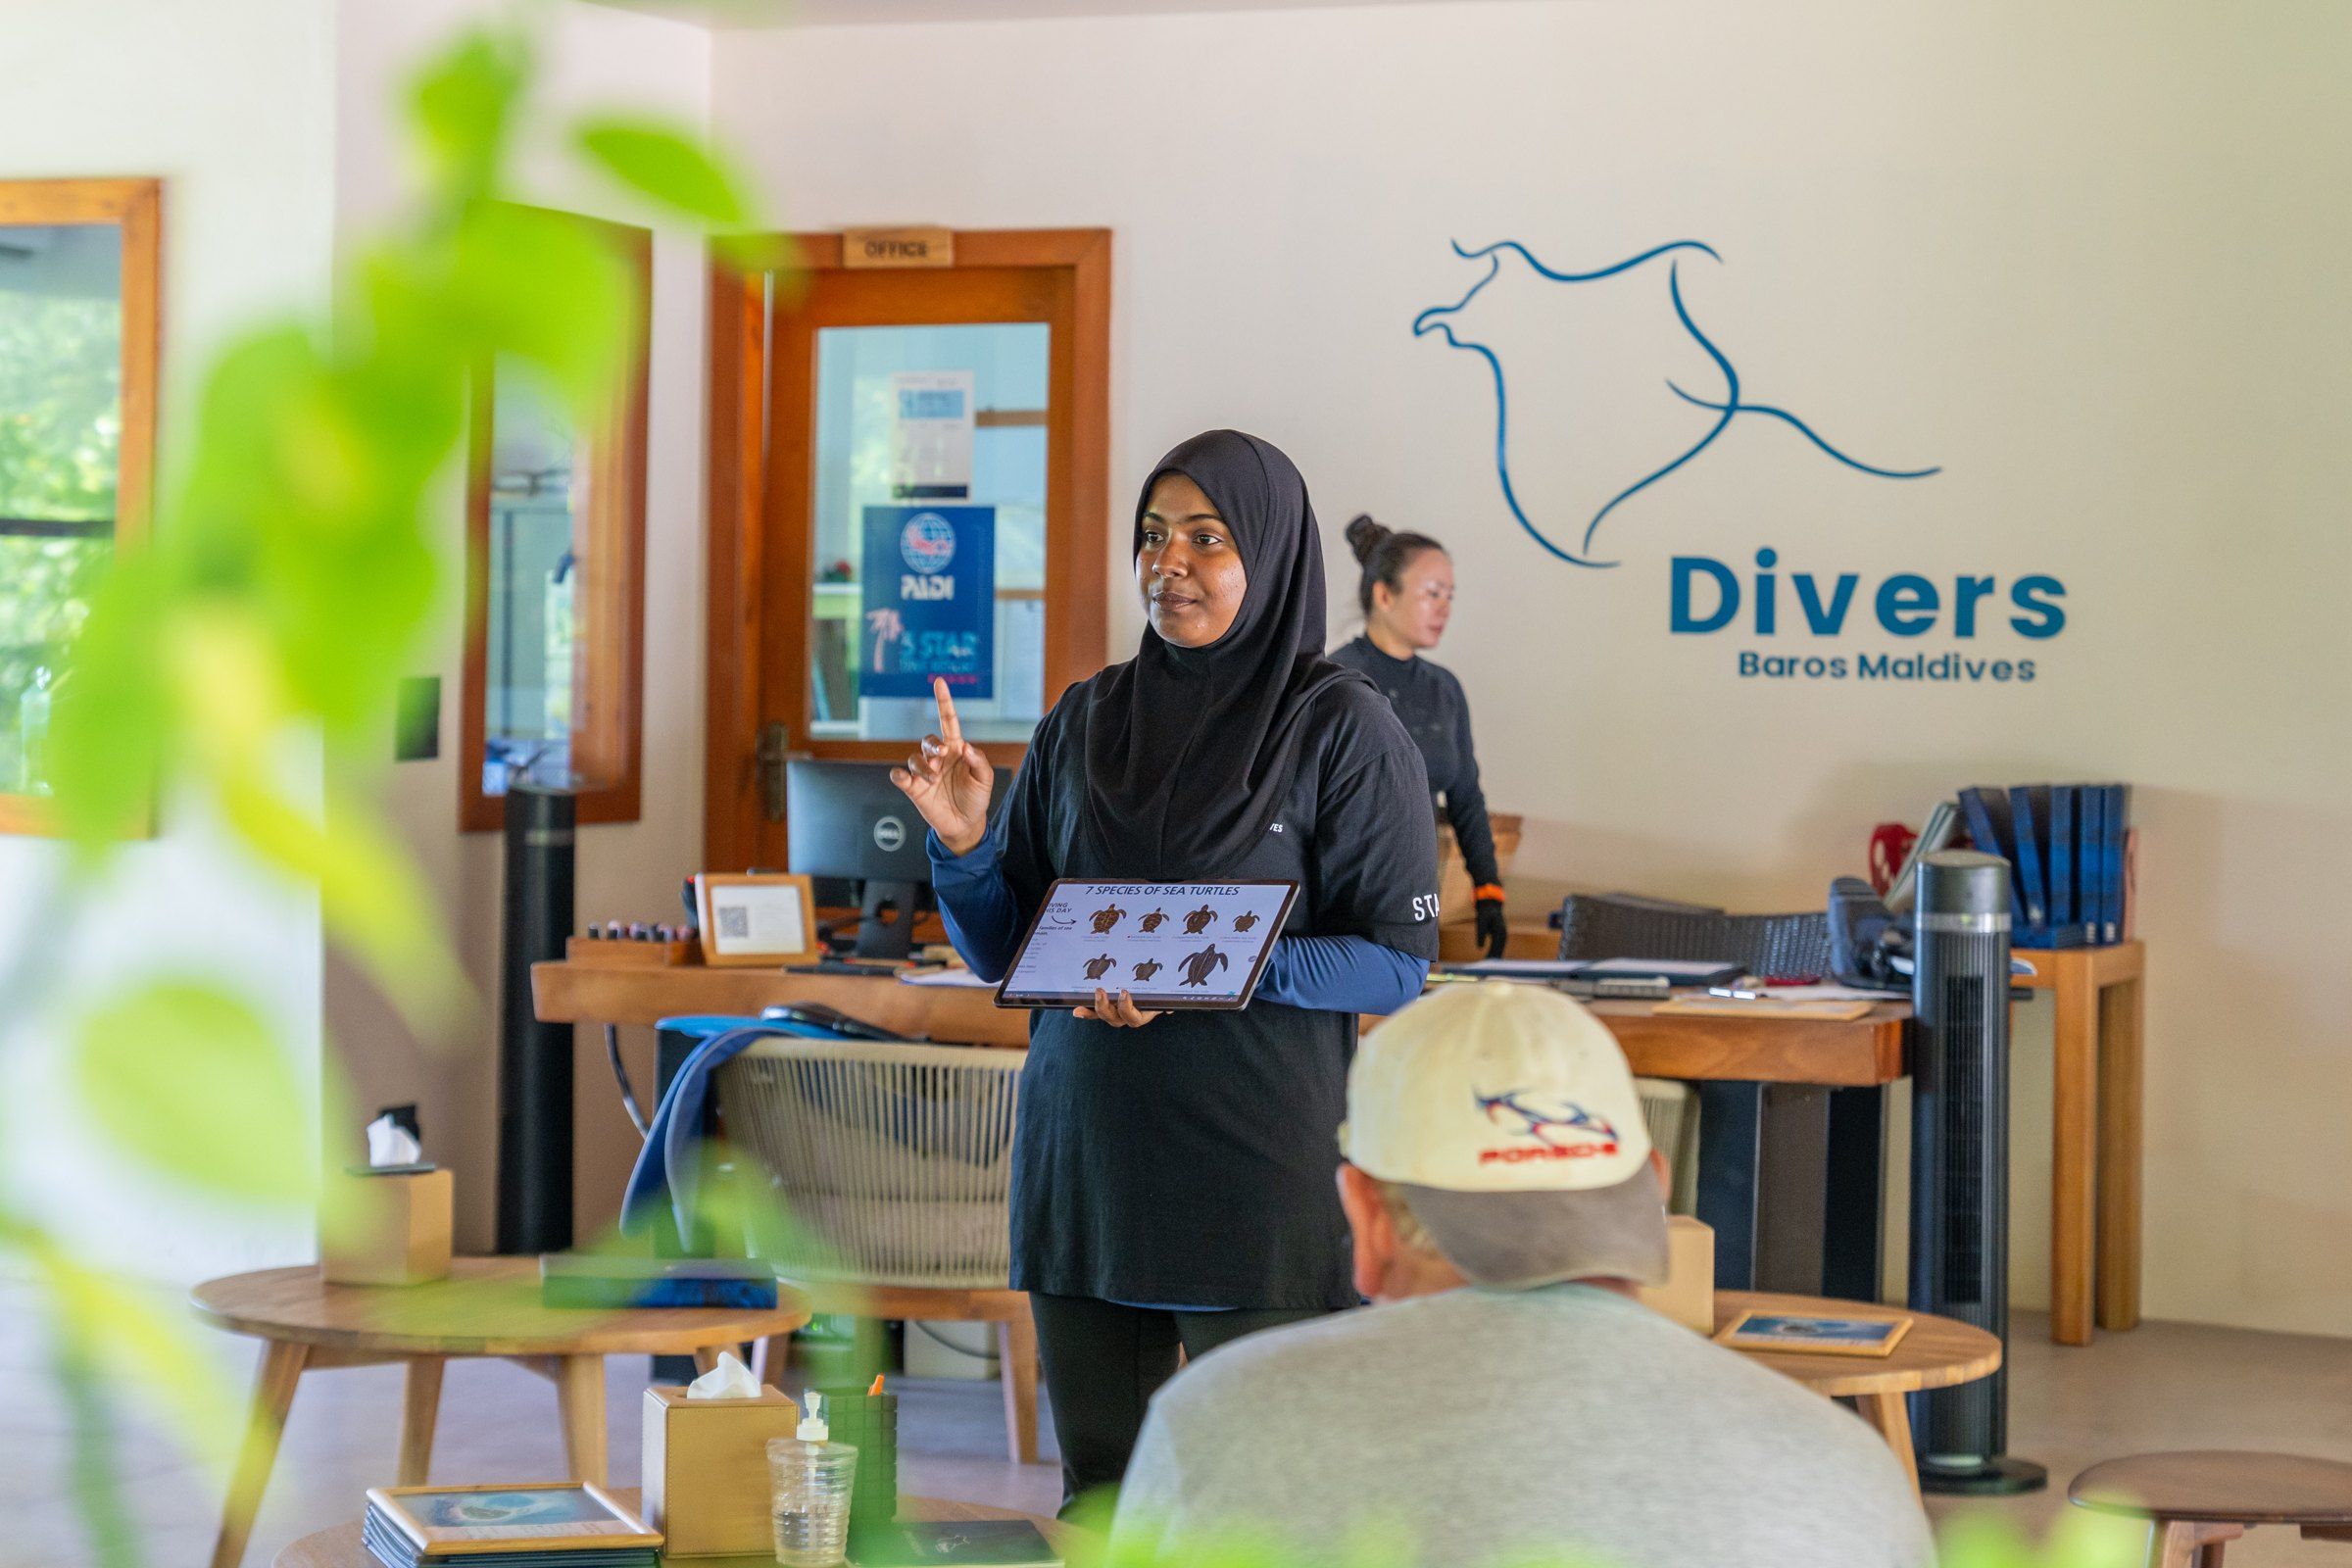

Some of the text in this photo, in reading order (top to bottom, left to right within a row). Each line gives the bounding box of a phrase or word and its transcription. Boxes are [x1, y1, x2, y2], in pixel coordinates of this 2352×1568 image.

[1670, 546, 2067, 640] Divers
[1739, 652, 2036, 682] Baros Maldives
[1085, 885, 1241, 896] 7 SPECIES OF SEA TURTLES
